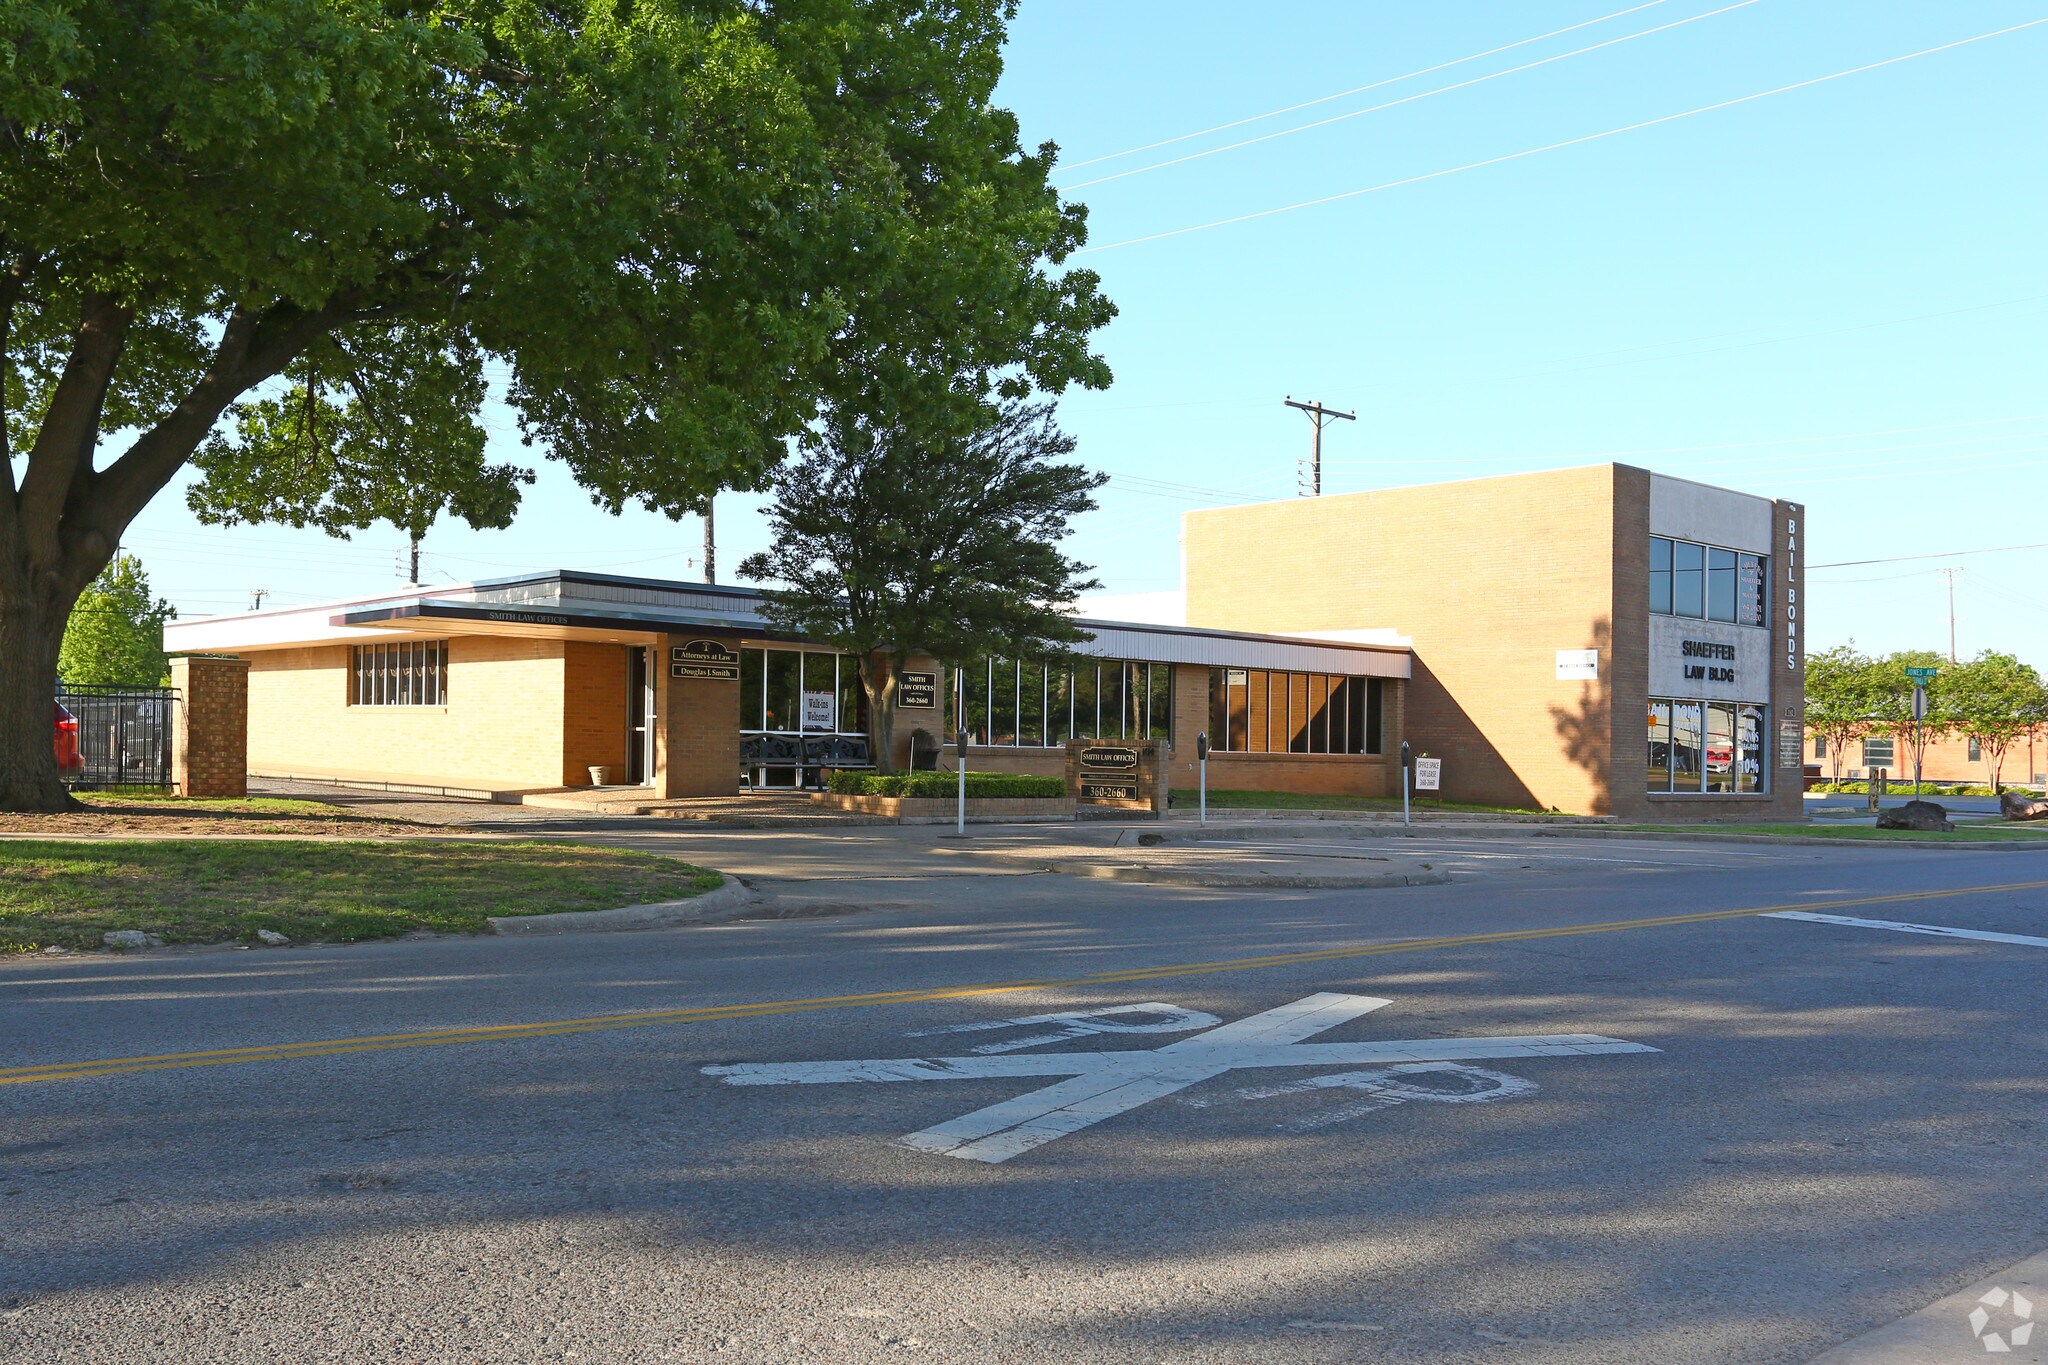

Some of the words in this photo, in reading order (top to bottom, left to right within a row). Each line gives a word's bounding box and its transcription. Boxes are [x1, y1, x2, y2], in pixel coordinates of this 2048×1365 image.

[1787, 519, 1796, 582] BAIL
[489, 611, 515, 620] SMITH
[518, 614, 536, 622] LAW
[537, 615, 568, 624] OFFICES
[1787, 588, 1796, 670] BONDS
[681, 651, 710, 661] Attorneys
[718, 653, 732, 661] Law
[1682, 639, 1735, 661] SHAEFFER
[681, 667, 706, 678] Douglas
[712, 669, 731, 677] Smith
[1684, 664, 1706, 680] LAW
[1708, 666, 1735, 683] BLDG
[1906, 668, 1923, 676] JONES
[913, 684, 934, 692] OFFICES
[807, 712, 830, 722] Welcome!
[1082, 753, 1100, 761] SMITH
[1113, 754, 1135, 762] OFFICES
[1740, 758, 1759, 774] 10%
[1089, 786, 1127, 798] 360-2660
